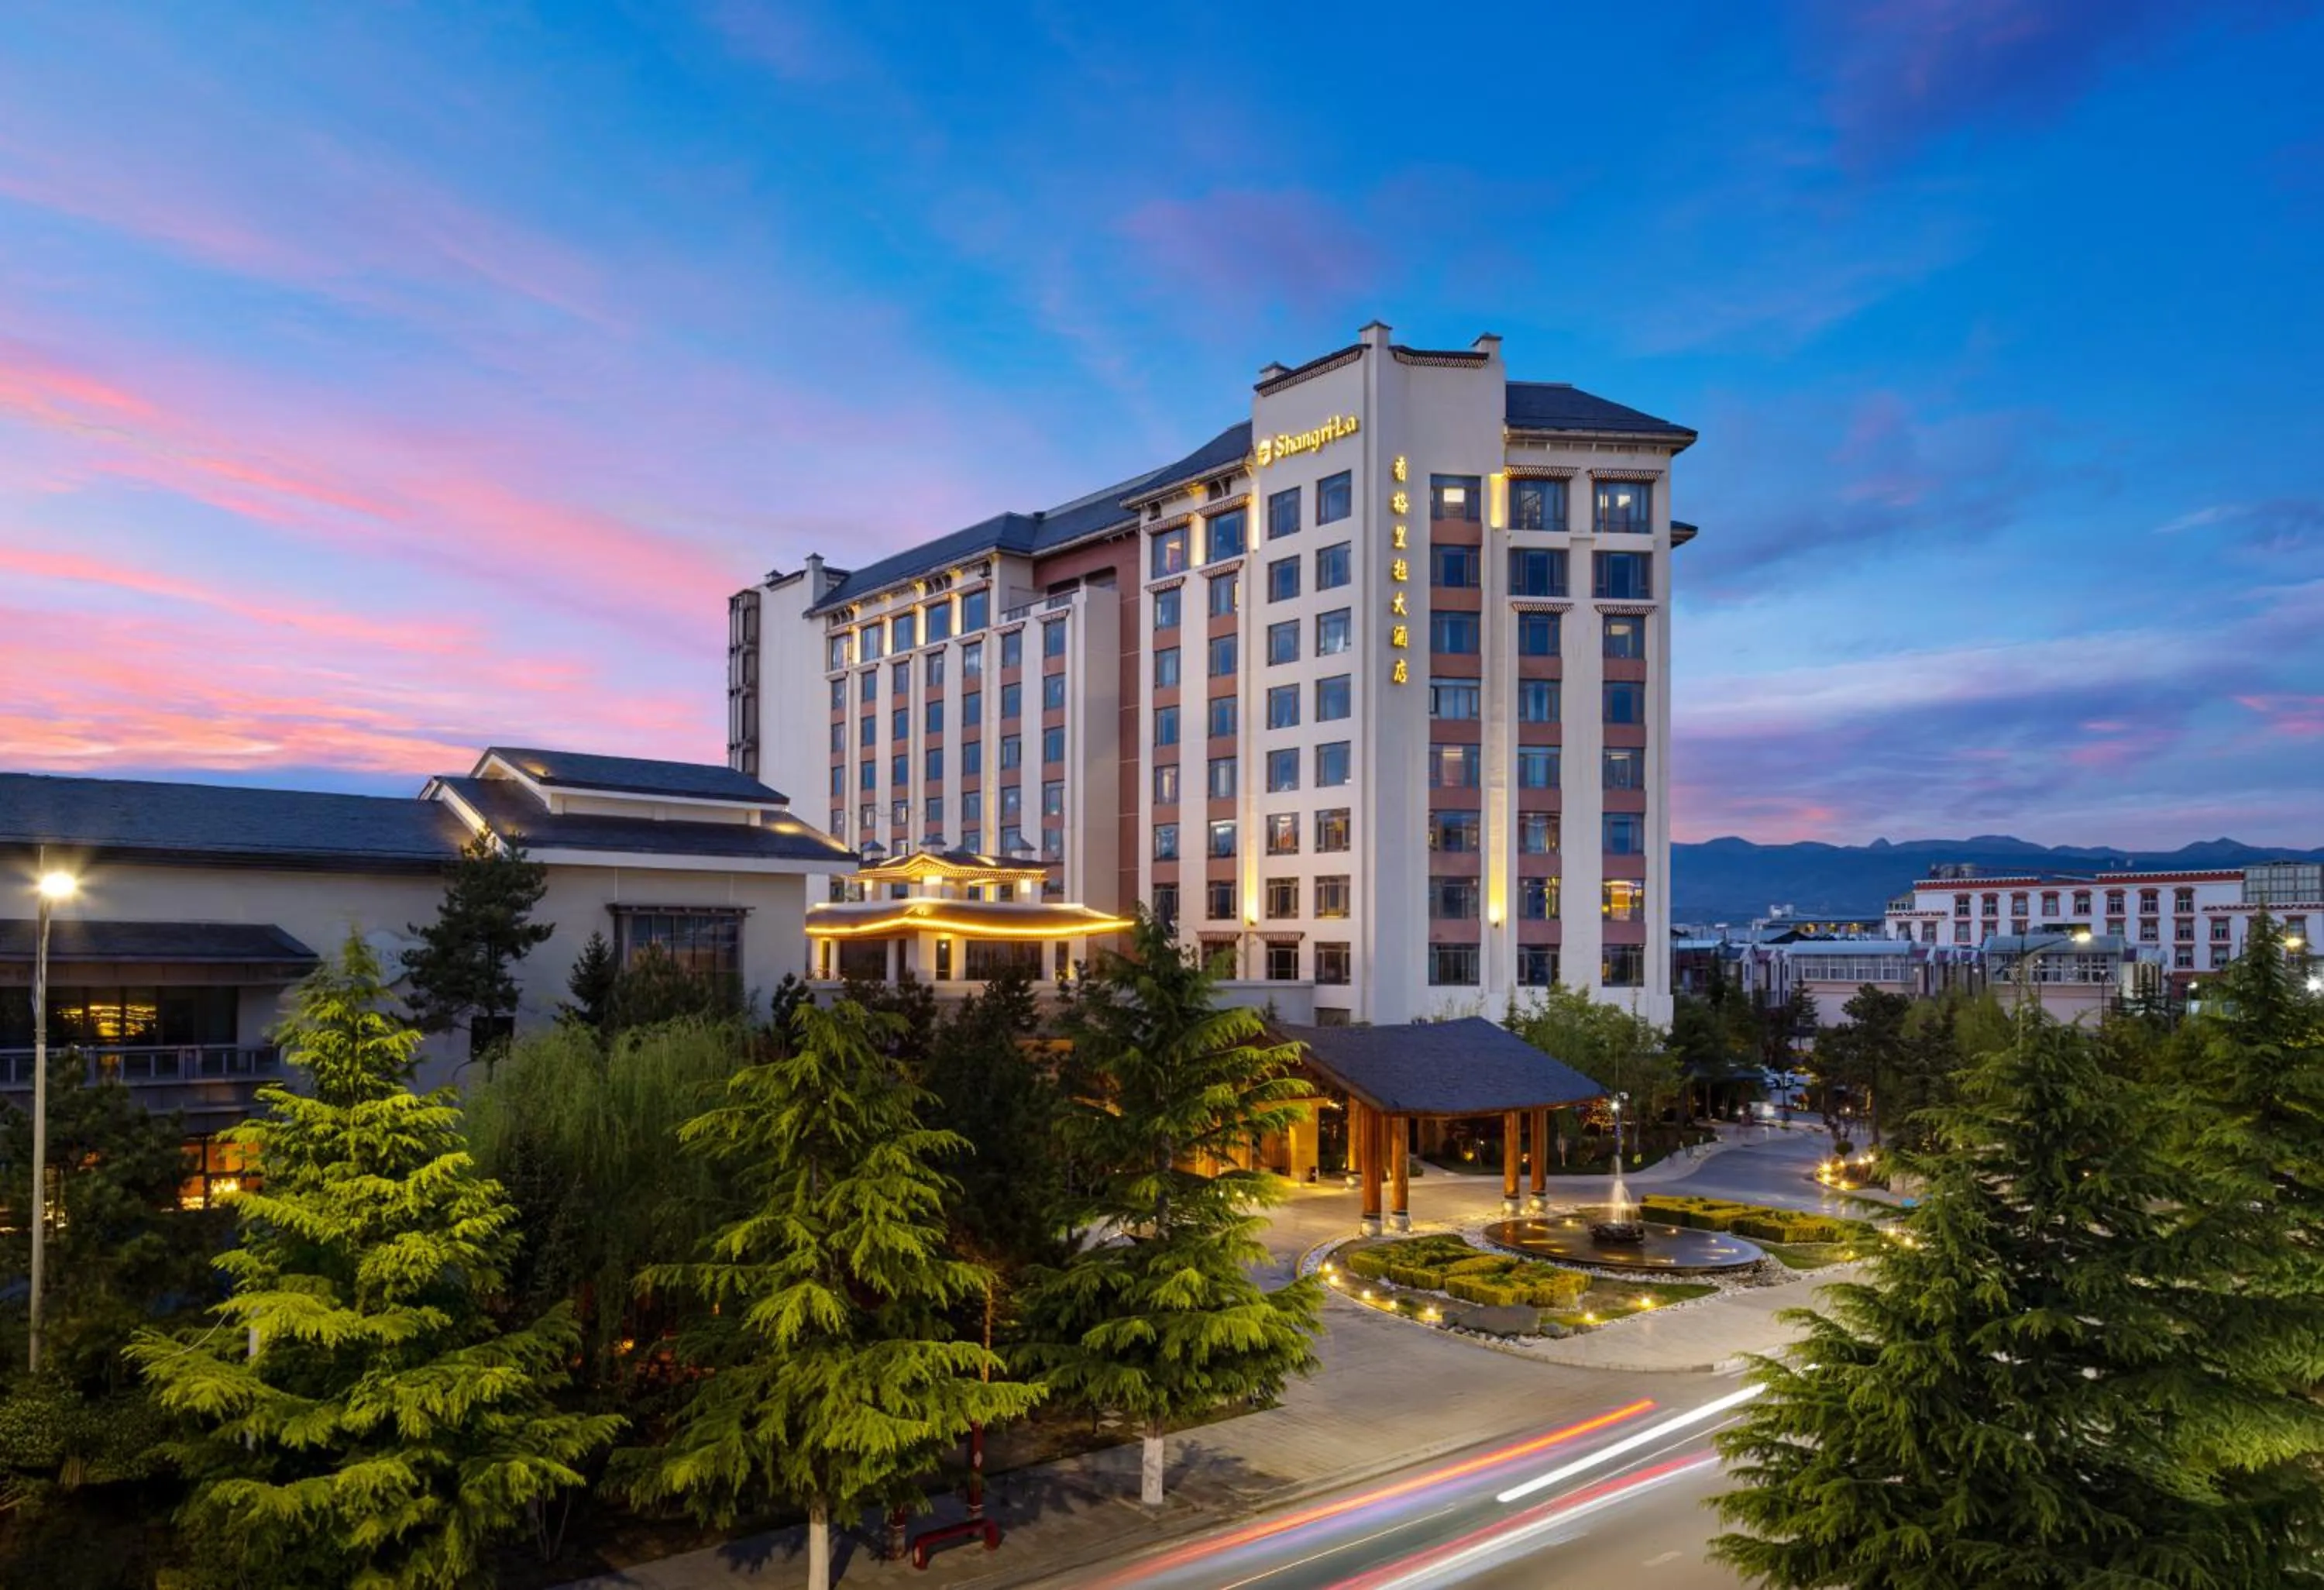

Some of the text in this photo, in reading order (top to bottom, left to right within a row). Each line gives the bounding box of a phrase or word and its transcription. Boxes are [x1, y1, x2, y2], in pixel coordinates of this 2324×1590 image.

[1274, 415, 1358, 456] Shangri-La
[1392, 456, 1408, 683] 香格里拉大酒店
